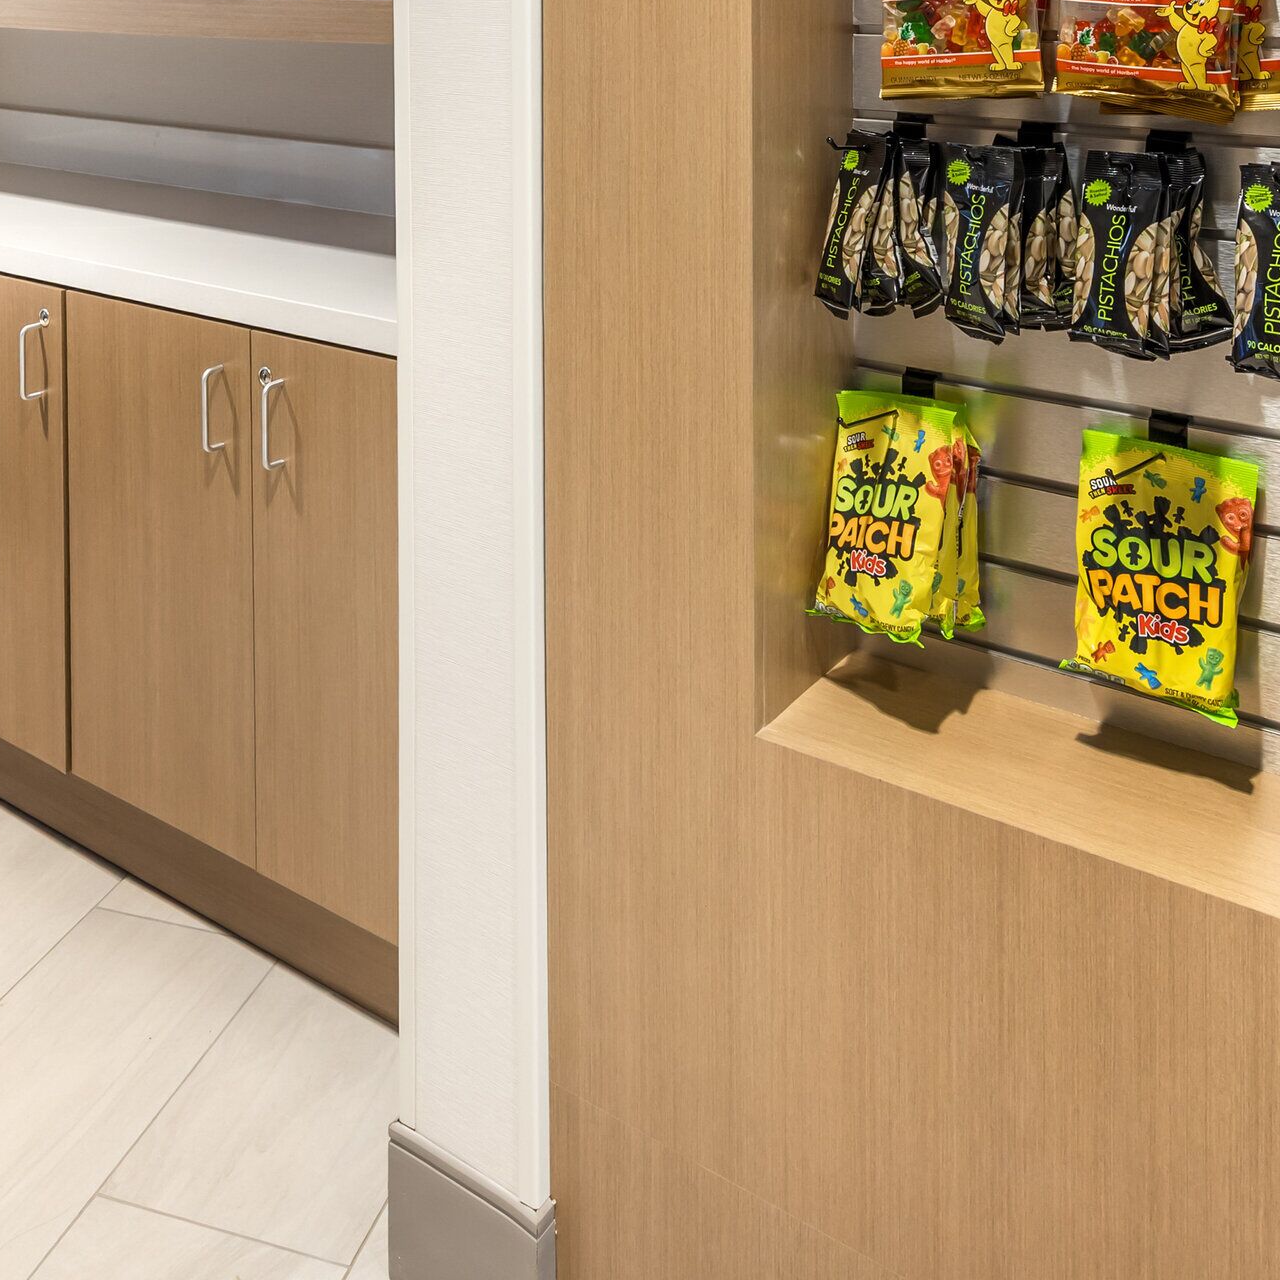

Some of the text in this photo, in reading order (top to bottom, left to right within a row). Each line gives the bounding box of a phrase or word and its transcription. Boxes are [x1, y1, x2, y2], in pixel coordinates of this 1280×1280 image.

[827, 177, 860, 268] PISTACHIOS
[1106, 203, 1136, 213] Wonderful
[959, 194, 986, 296] PISTACHIOS
[1098, 214, 1126, 321] PISTACHIOS
[958, 301, 986, 314] CALORIES
[1247, 340, 1256, 349] 90
[847, 432, 866, 445] SOUR
[835, 477, 918, 520] SOUR
[1089, 488, 1106, 499] THEN
[1090, 477, 1117, 490] SOUR
[829, 515, 916, 560] PATCH
[850, 550, 887, 576] Kids
[1092, 528, 1214, 584] SOUR
[1088, 570, 1221, 626] PATCH
[1137, 614, 1189, 644] Kids
